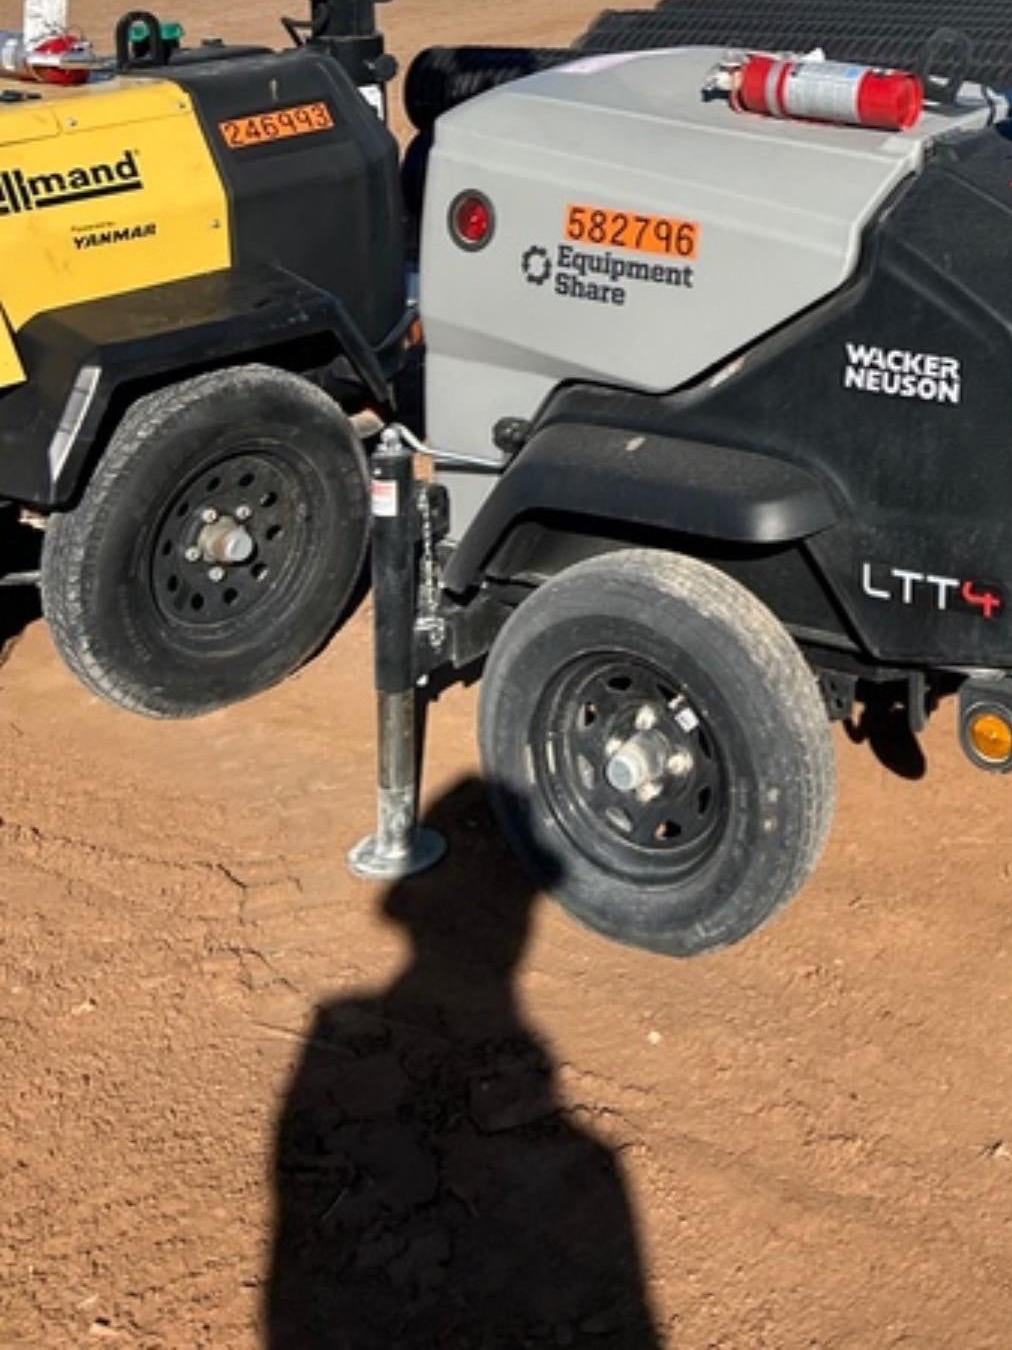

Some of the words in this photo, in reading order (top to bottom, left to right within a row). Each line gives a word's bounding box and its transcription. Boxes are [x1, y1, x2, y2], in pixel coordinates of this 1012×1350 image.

[0, 149, 138, 214] llmand
[73, 222, 157, 250] YANMAR
[567, 206, 695, 257] 582796
[556, 244, 694, 288] Equipment
[554, 272, 626, 305] Share
[845, 341, 960, 381] WACKER
[844, 364, 960, 404] NEUSON
[862, 561, 1001, 619] LTT4
